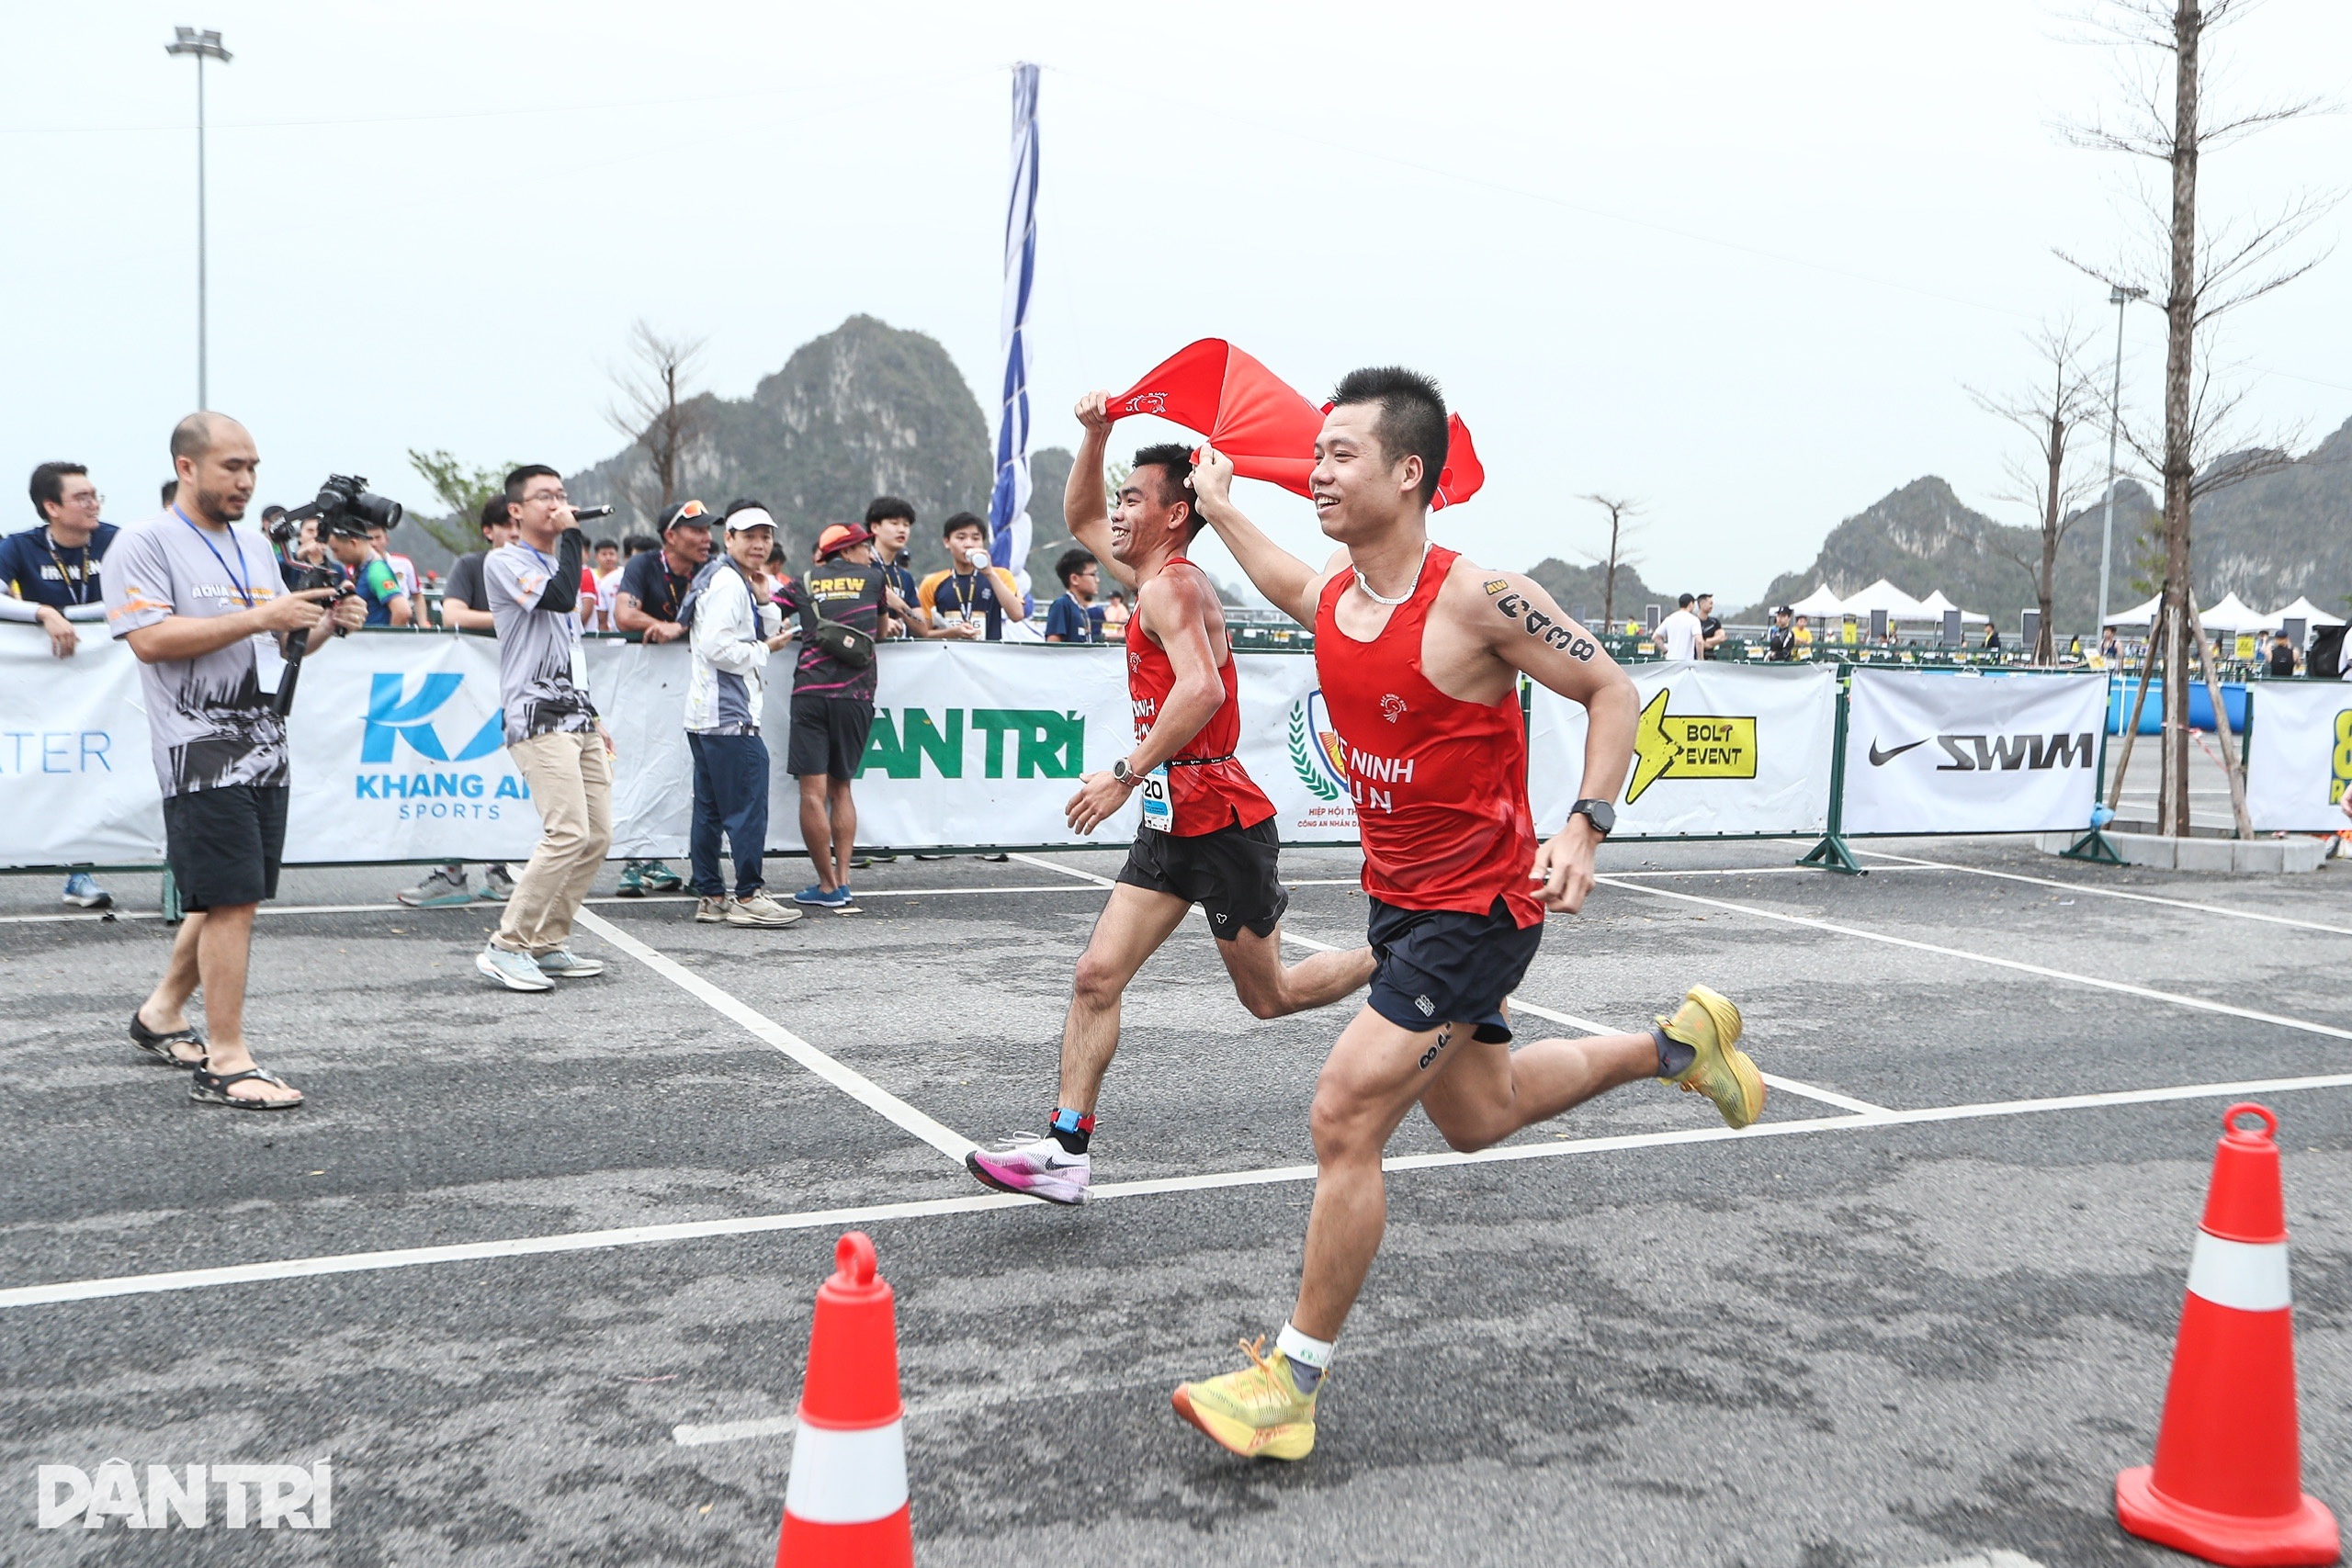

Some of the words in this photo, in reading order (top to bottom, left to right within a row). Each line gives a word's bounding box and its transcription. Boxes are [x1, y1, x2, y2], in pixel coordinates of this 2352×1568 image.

[191, 584, 230, 599] AQUA
[810, 577, 865, 594] CREW
[1687, 724, 1734, 742] BOLT
[0, 731, 112, 773] TER
[1687, 748, 1743, 765] EVENT
[1936, 732, 2094, 771] SWIM
[1350, 746, 1415, 784] NINH
[356, 773, 484, 800] KHANG
[399, 803, 501, 820] SPORTS
[1328, 806, 1344, 818] HỘI
